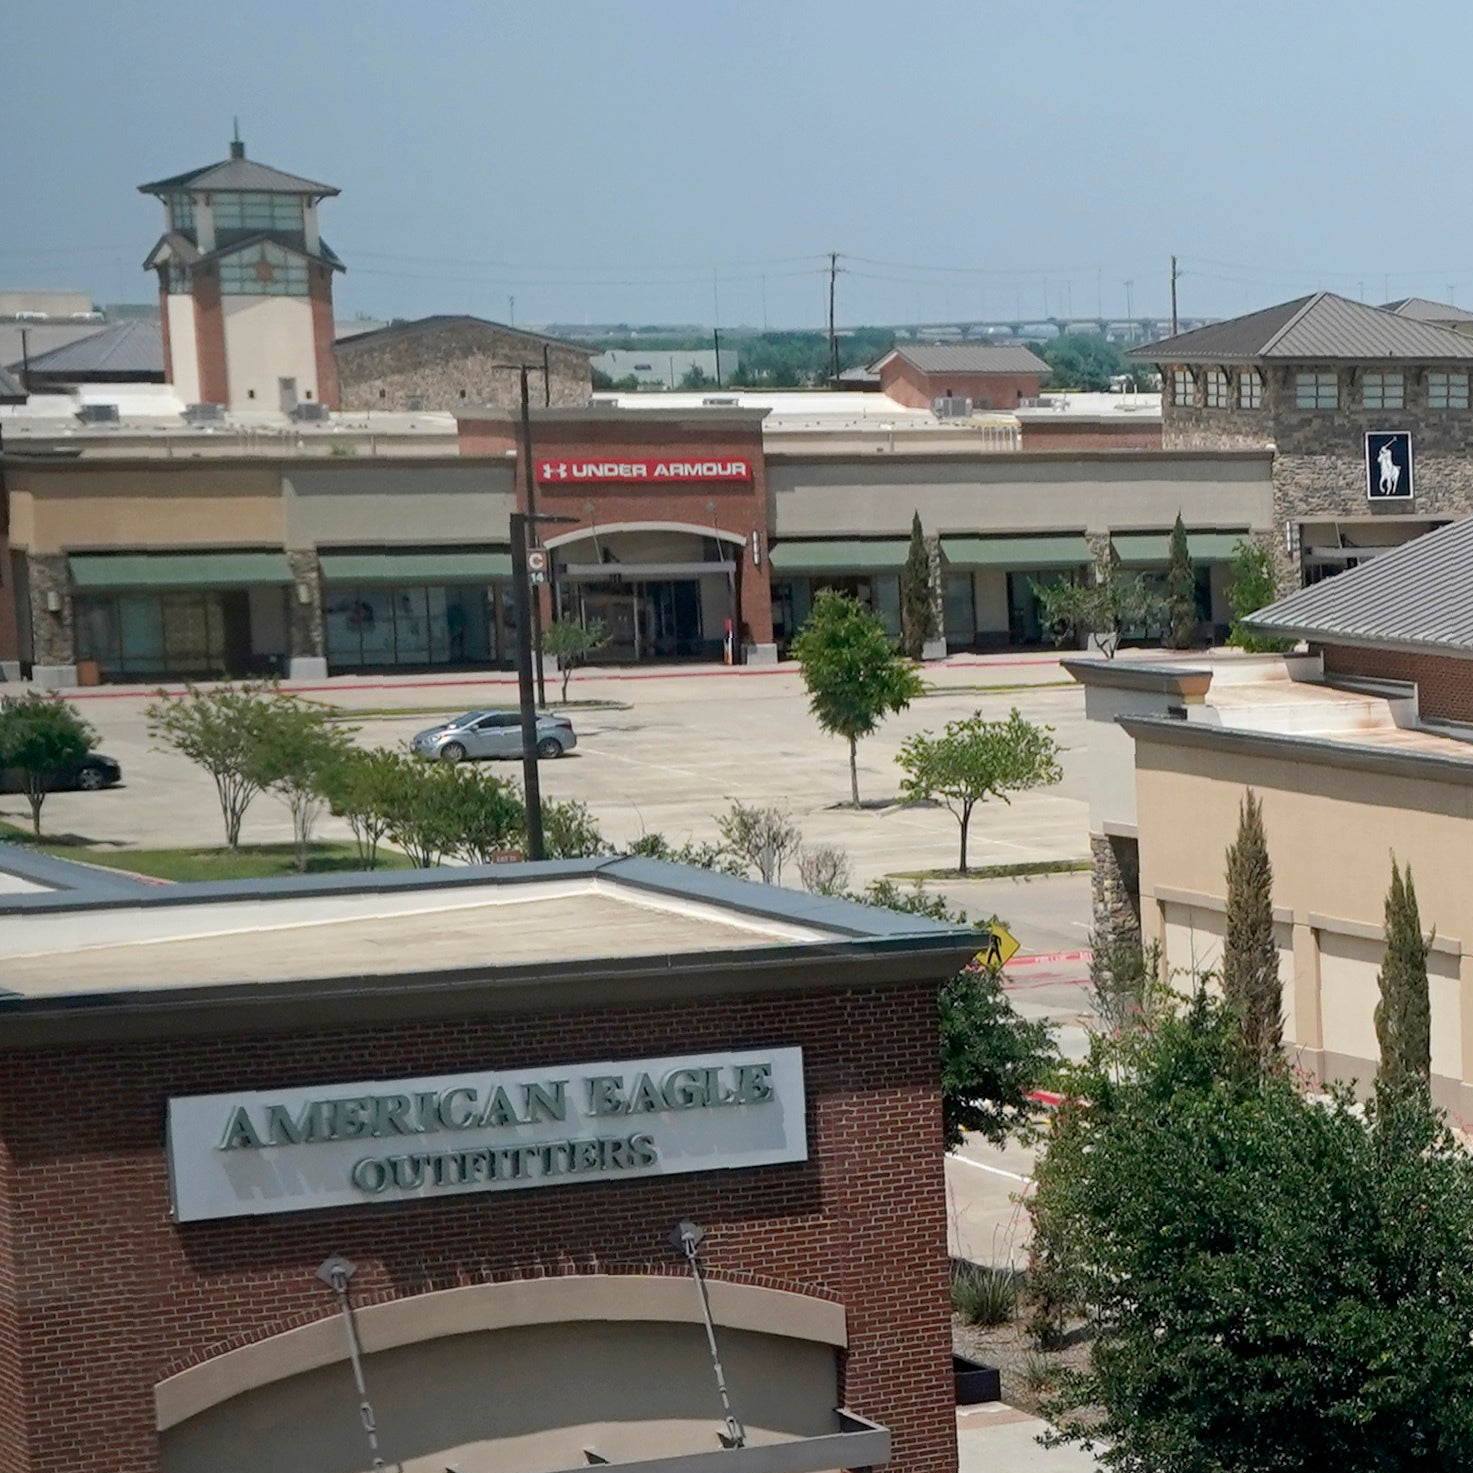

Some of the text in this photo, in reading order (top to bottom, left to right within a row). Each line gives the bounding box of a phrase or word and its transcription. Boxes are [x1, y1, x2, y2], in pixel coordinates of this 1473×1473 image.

[572, 462, 747, 477] UNDER ARMOUR
[529, 553, 545, 569] C
[530, 573, 545, 584] 14
[217, 1062, 775, 1152] AMERICAN EAGLE
[351, 1132, 660, 1195] OUTFITTERS
